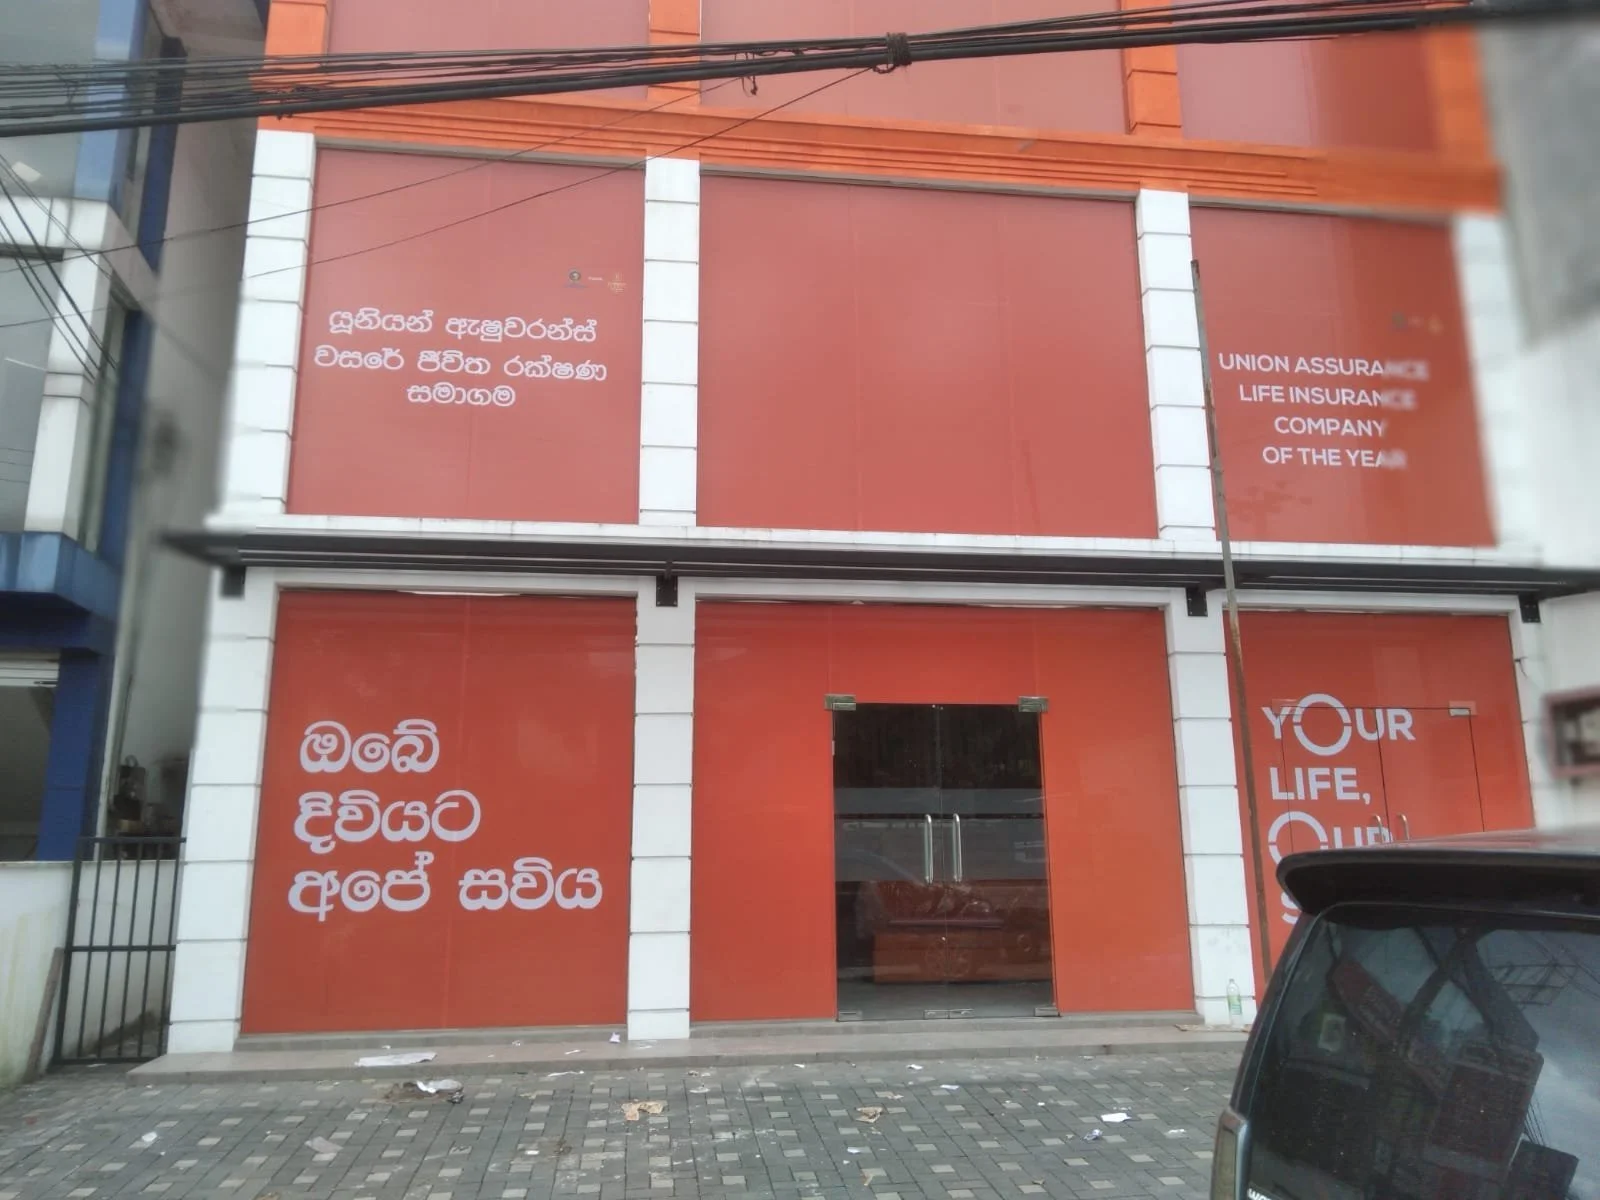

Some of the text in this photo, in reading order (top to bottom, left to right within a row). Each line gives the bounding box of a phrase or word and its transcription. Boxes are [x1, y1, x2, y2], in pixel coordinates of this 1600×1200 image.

[314, 344, 405, 370] වසරේ
[1218, 352, 1290, 373] UNION
[406, 382, 516, 407] සමාගම
[1239, 384, 1285, 403] LIFE
[1274, 416, 1387, 438] COMPANY
[1262, 446, 1293, 464] OF
[1297, 447, 1342, 466] THE
[1262, 693, 1416, 756] YOUR
[1269, 767, 1371, 805] LIFE,
[287, 850, 603, 922] අපේ සවිය
